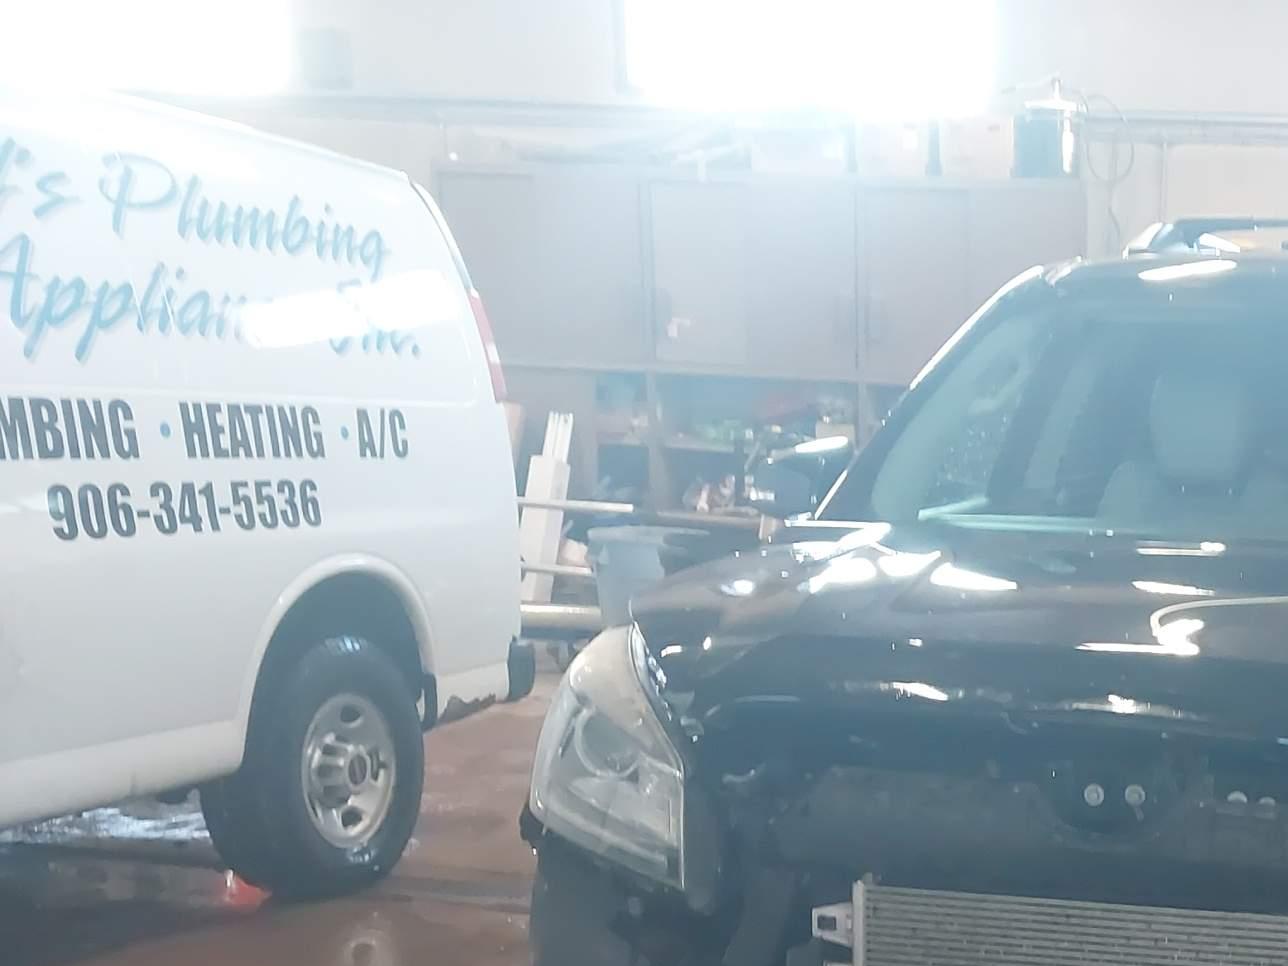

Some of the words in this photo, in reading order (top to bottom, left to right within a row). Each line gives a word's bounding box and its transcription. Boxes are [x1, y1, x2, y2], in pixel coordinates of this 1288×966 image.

[99, 153, 389, 283] Plumbing
[178, 401, 326, 459] HEATING
[356, 408, 409, 458] A/C
[46, 478, 322, 541] 906-341-5536
